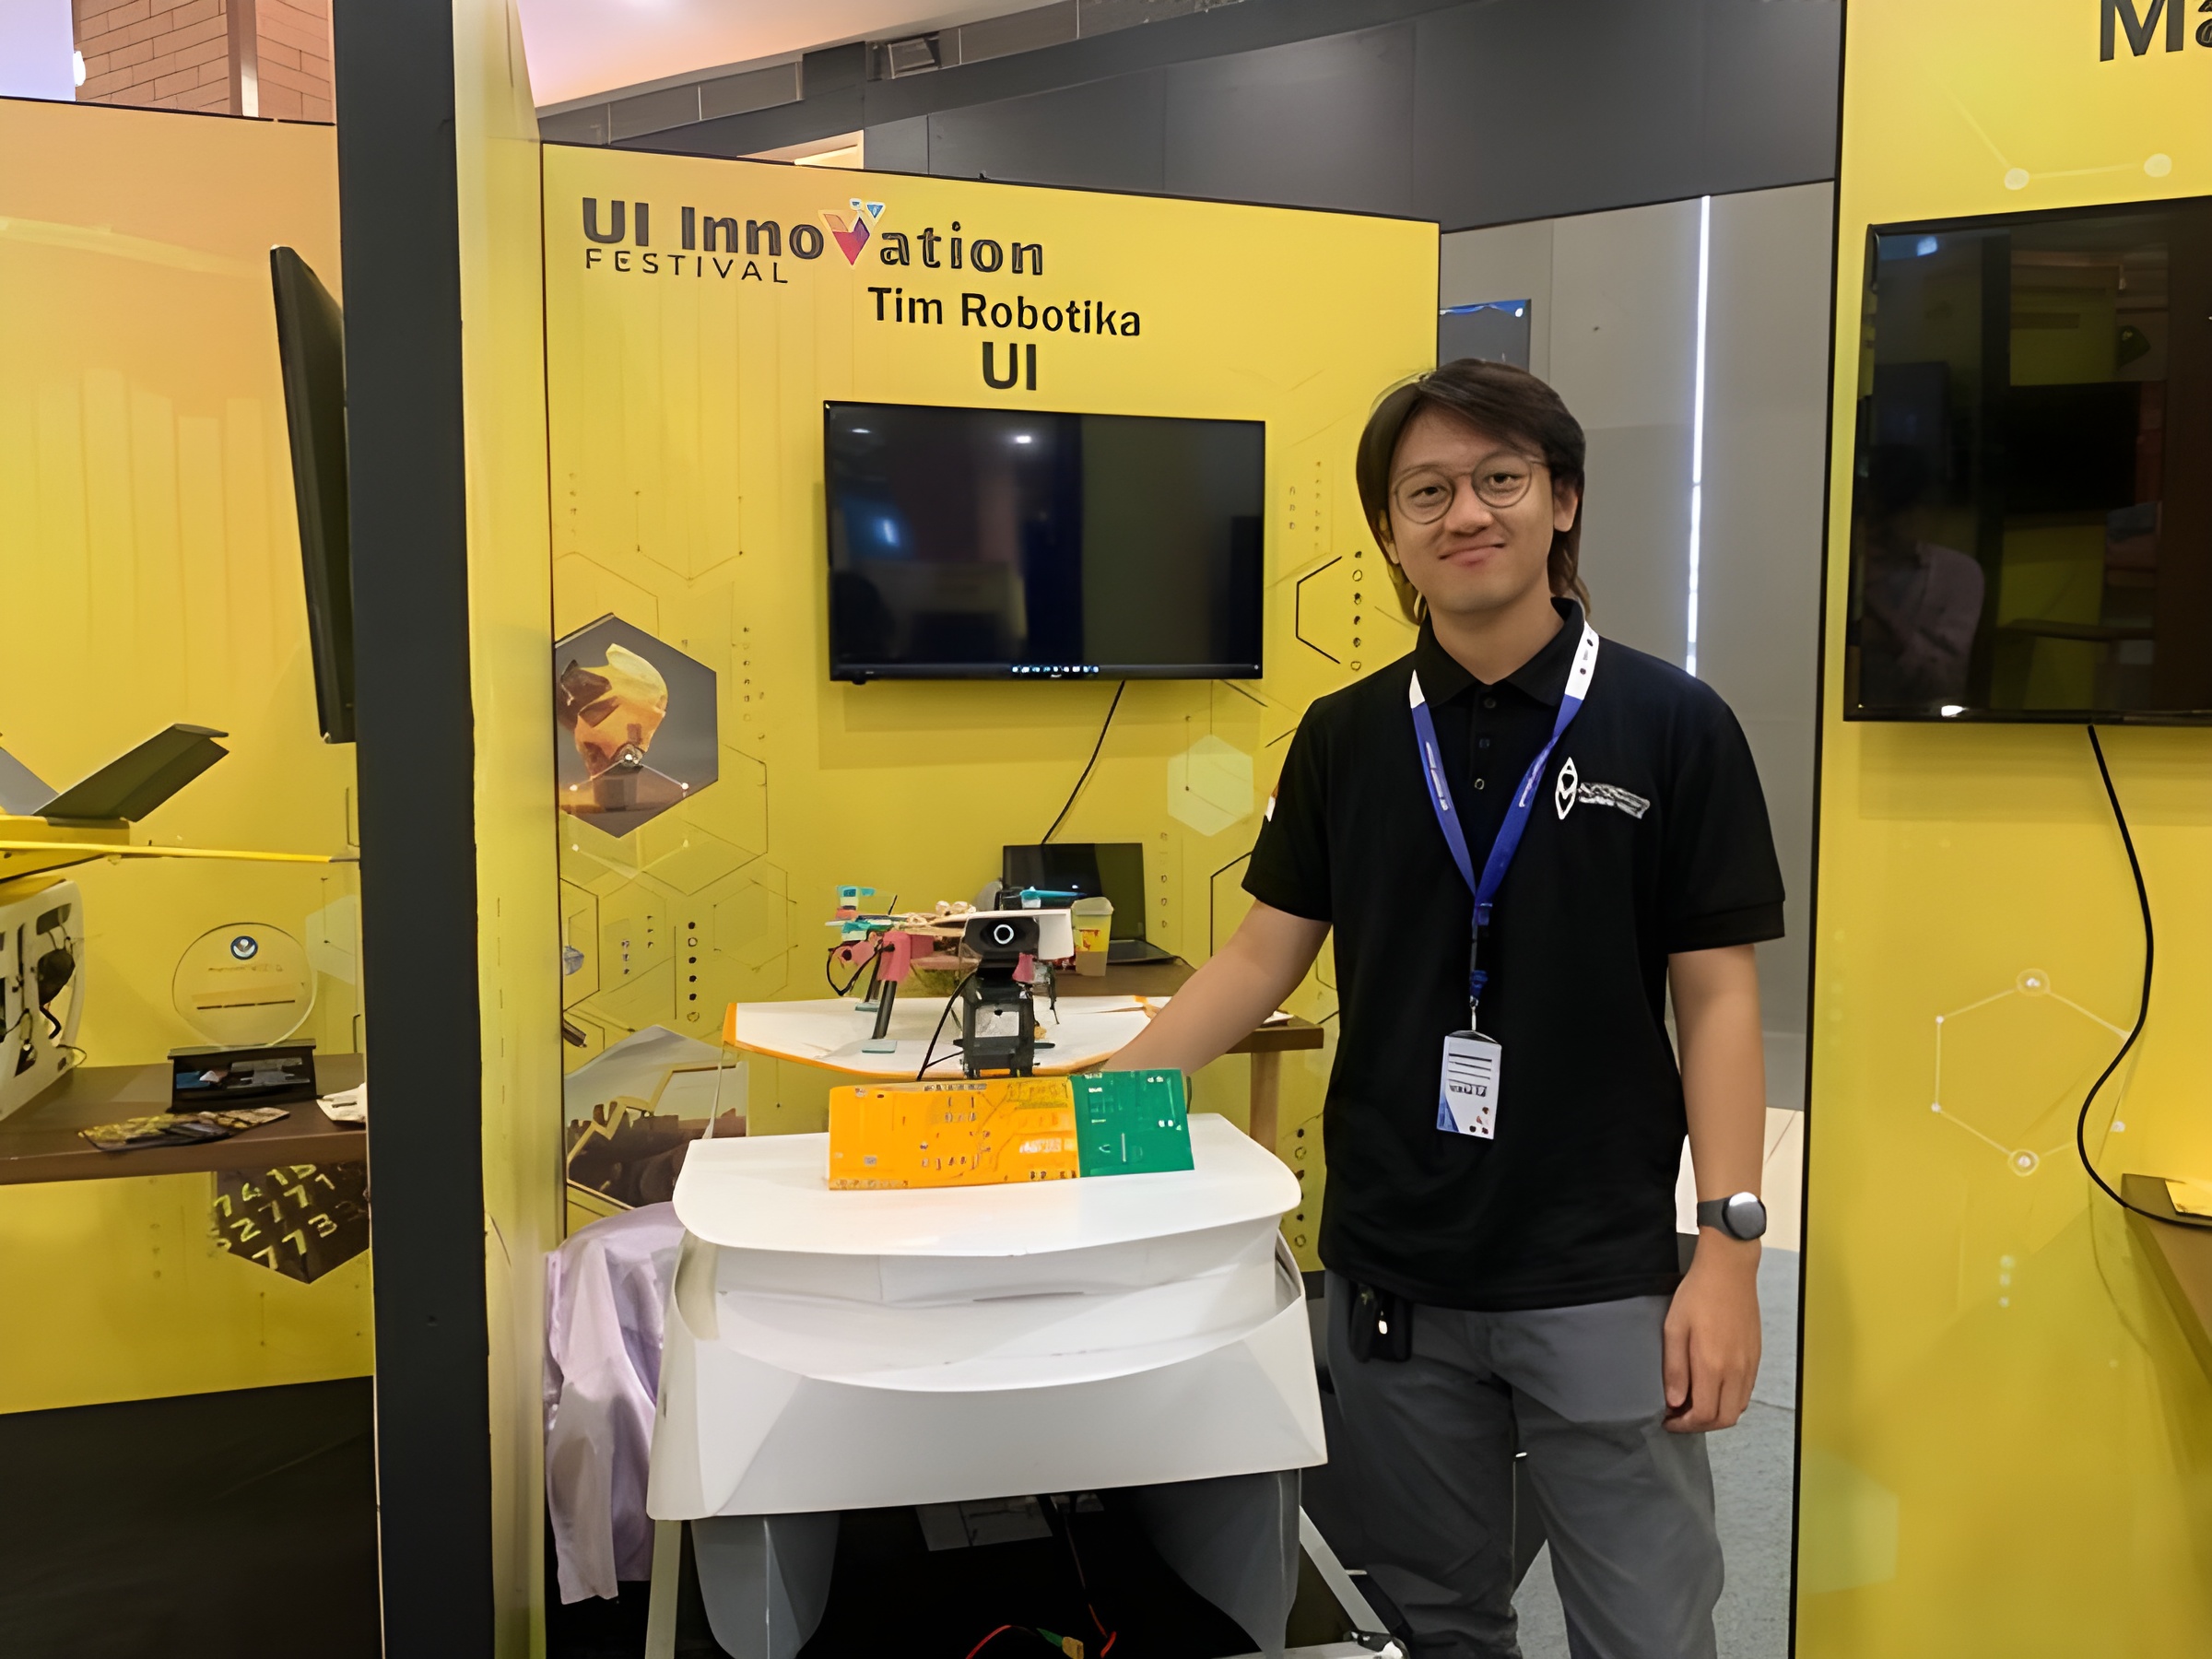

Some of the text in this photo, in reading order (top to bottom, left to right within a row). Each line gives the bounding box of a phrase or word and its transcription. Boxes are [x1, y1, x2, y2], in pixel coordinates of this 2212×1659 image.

[582, 196, 650, 247] UI
[585, 248, 789, 284] FESTIVAL
[867, 286, 1140, 337] Tim Robotika
[982, 341, 1037, 392] UI
